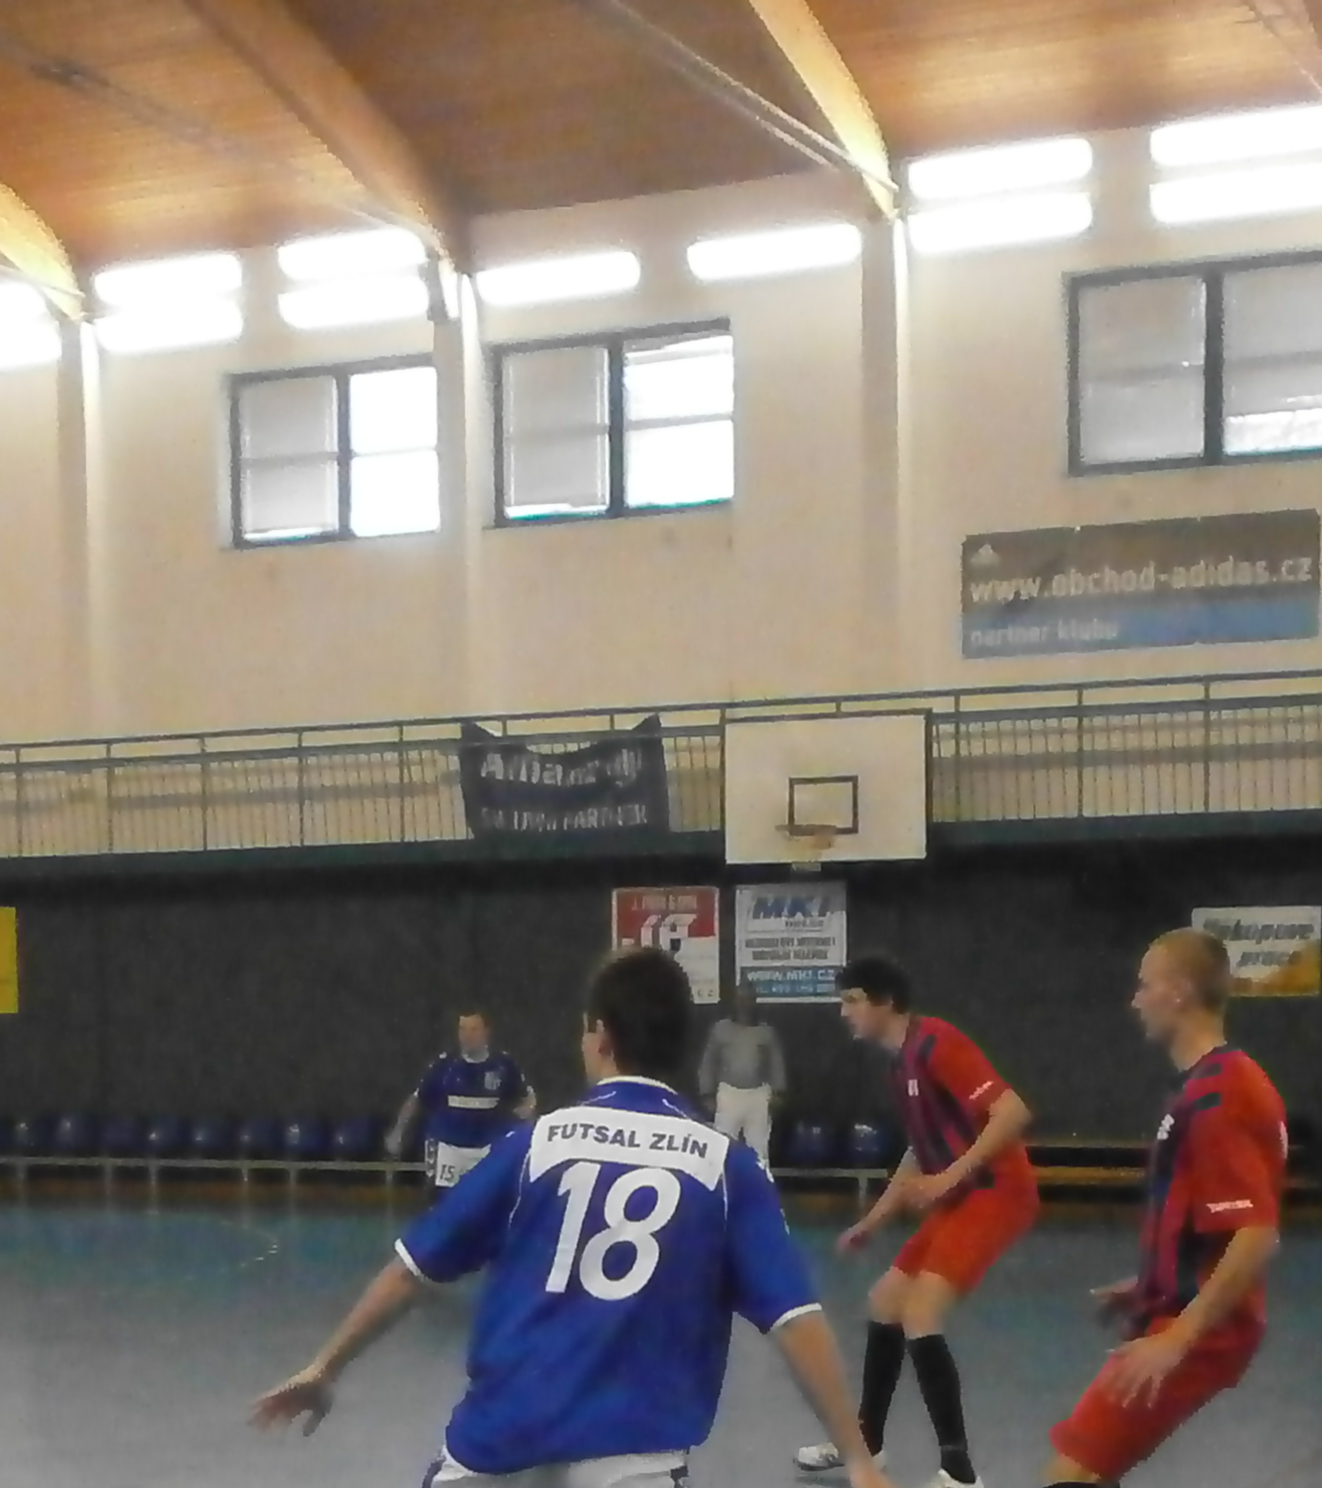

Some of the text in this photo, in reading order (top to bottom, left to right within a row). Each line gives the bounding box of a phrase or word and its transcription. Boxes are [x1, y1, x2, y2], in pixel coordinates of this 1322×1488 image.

[969, 554, 1312, 603] www.obchod-adidas.cz
[547, 1123, 709, 1159] FUTSAL ZLÍN
[544, 1160, 681, 1301] 18
